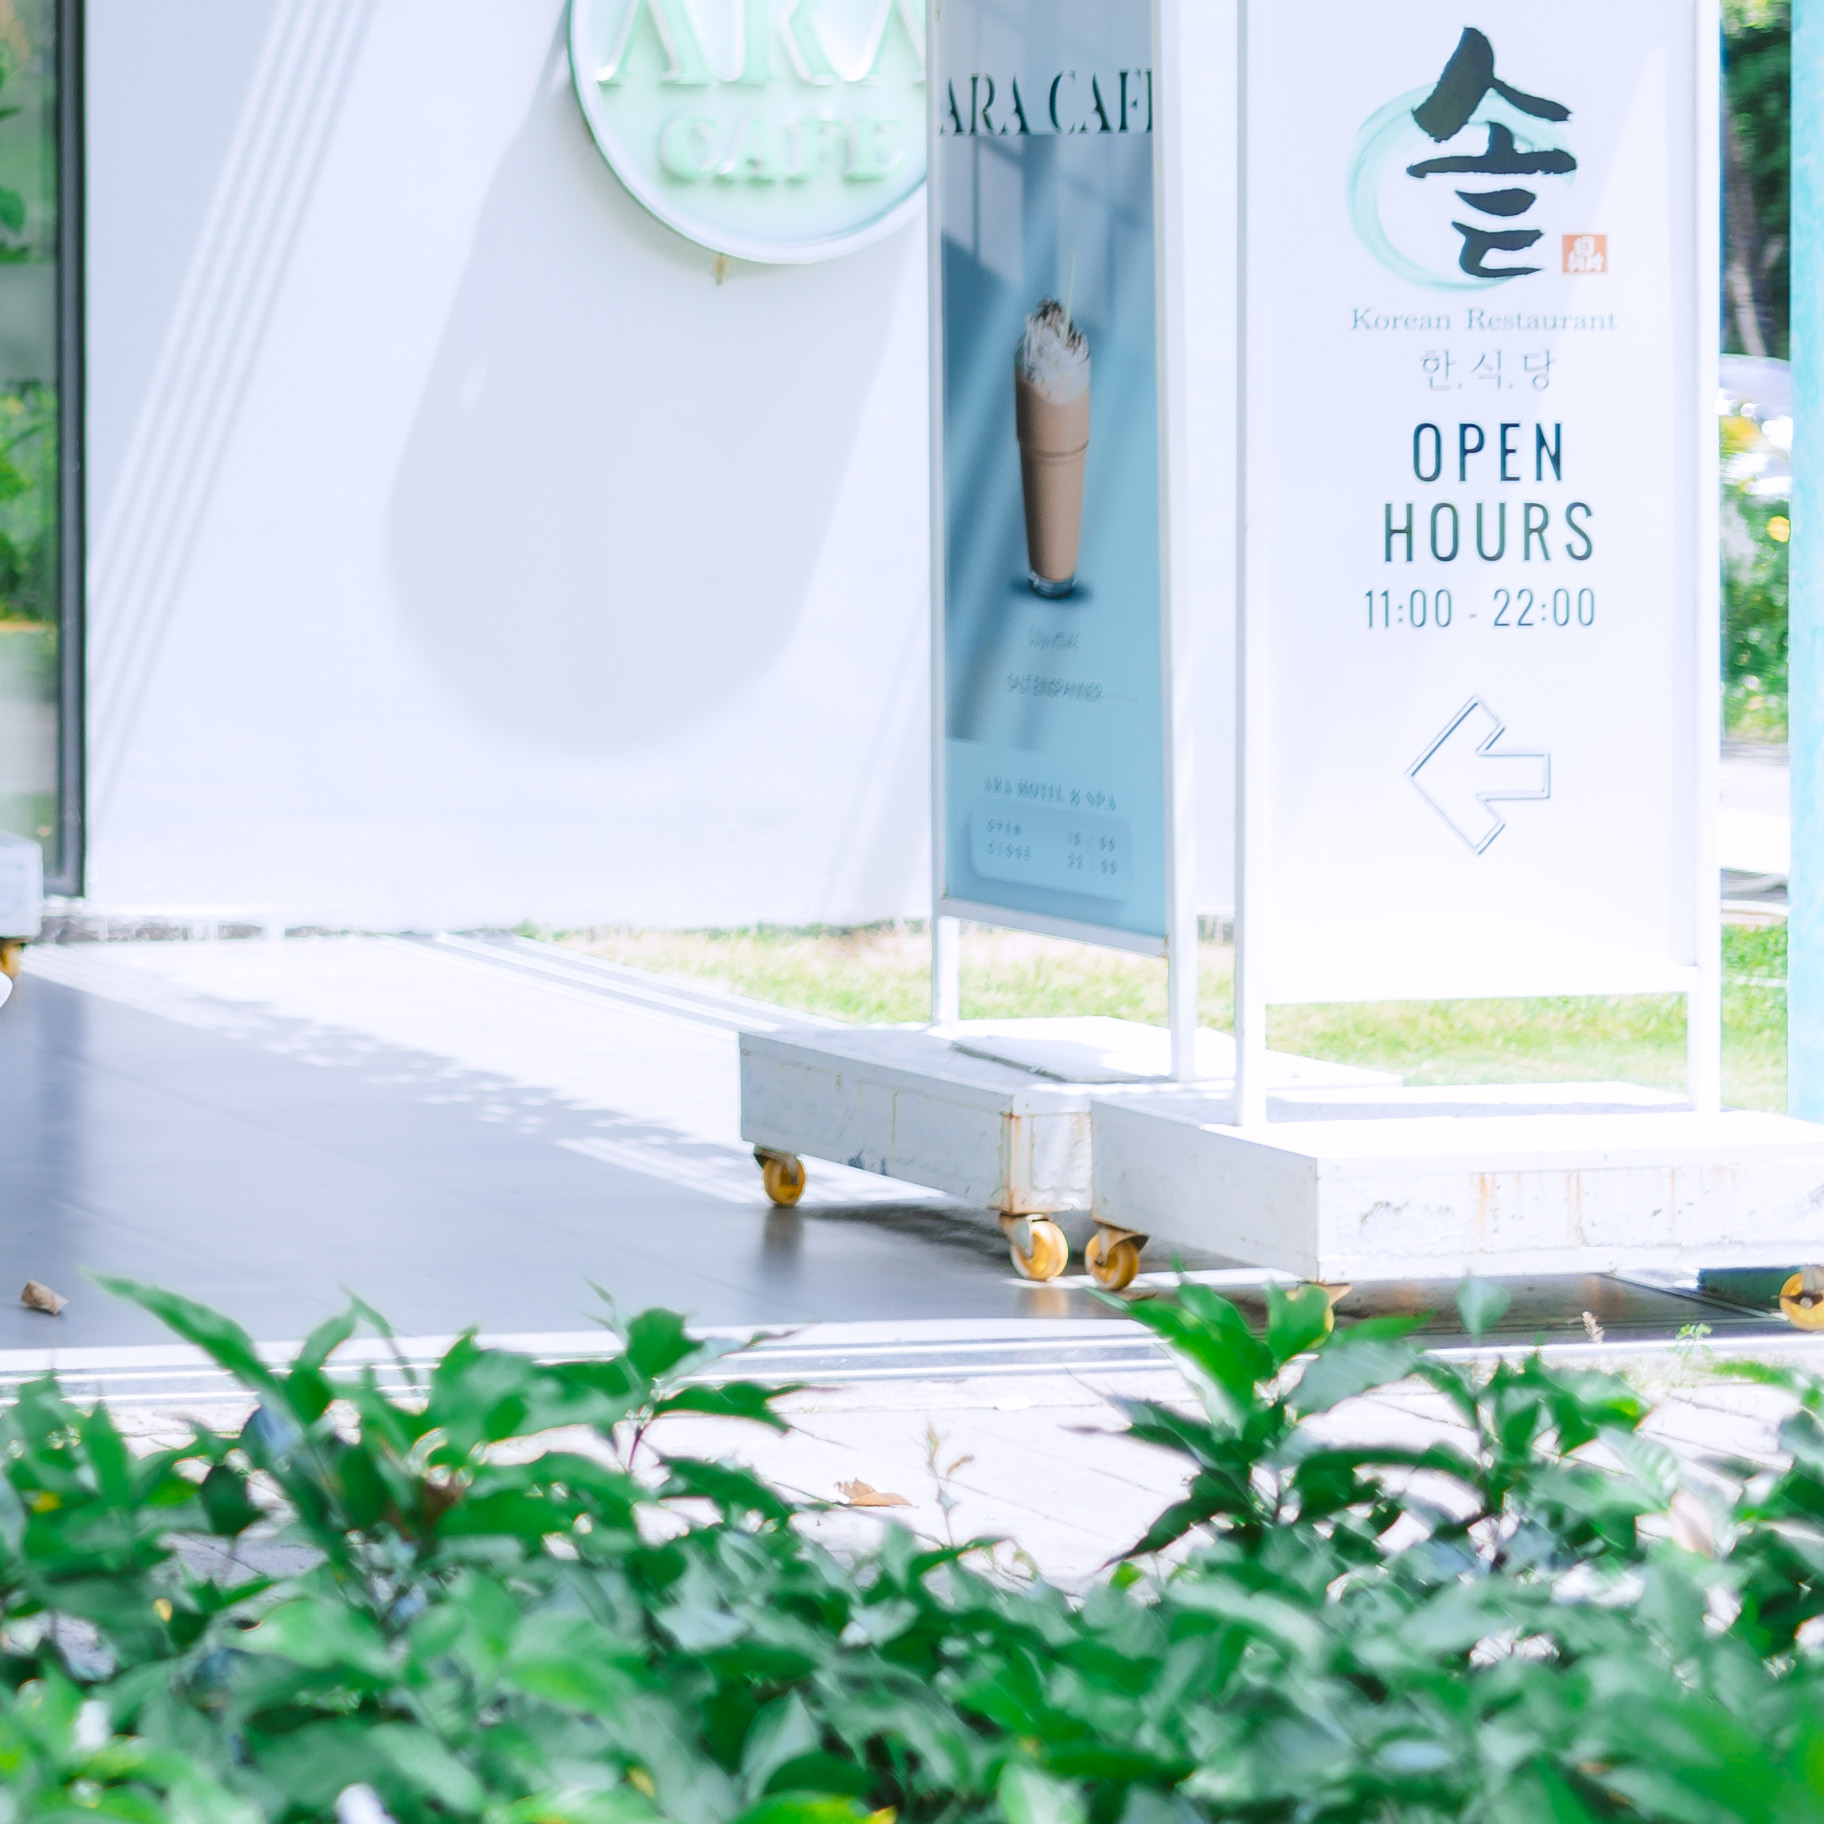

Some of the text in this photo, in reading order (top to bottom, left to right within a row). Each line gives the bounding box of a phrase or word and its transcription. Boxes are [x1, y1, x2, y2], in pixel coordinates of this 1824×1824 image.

[939, 73, 1032, 136] ARA
[658, 116, 907, 184] CAFE
[1351, 306, 1617, 332] Korean Restaurant
[1412, 422, 1563, 483] OPEN
[1383, 501, 1593, 563] HOURS
[1363, 588, 1453, 629] 11:00
[1493, 587, 1595, 627] 22:00
